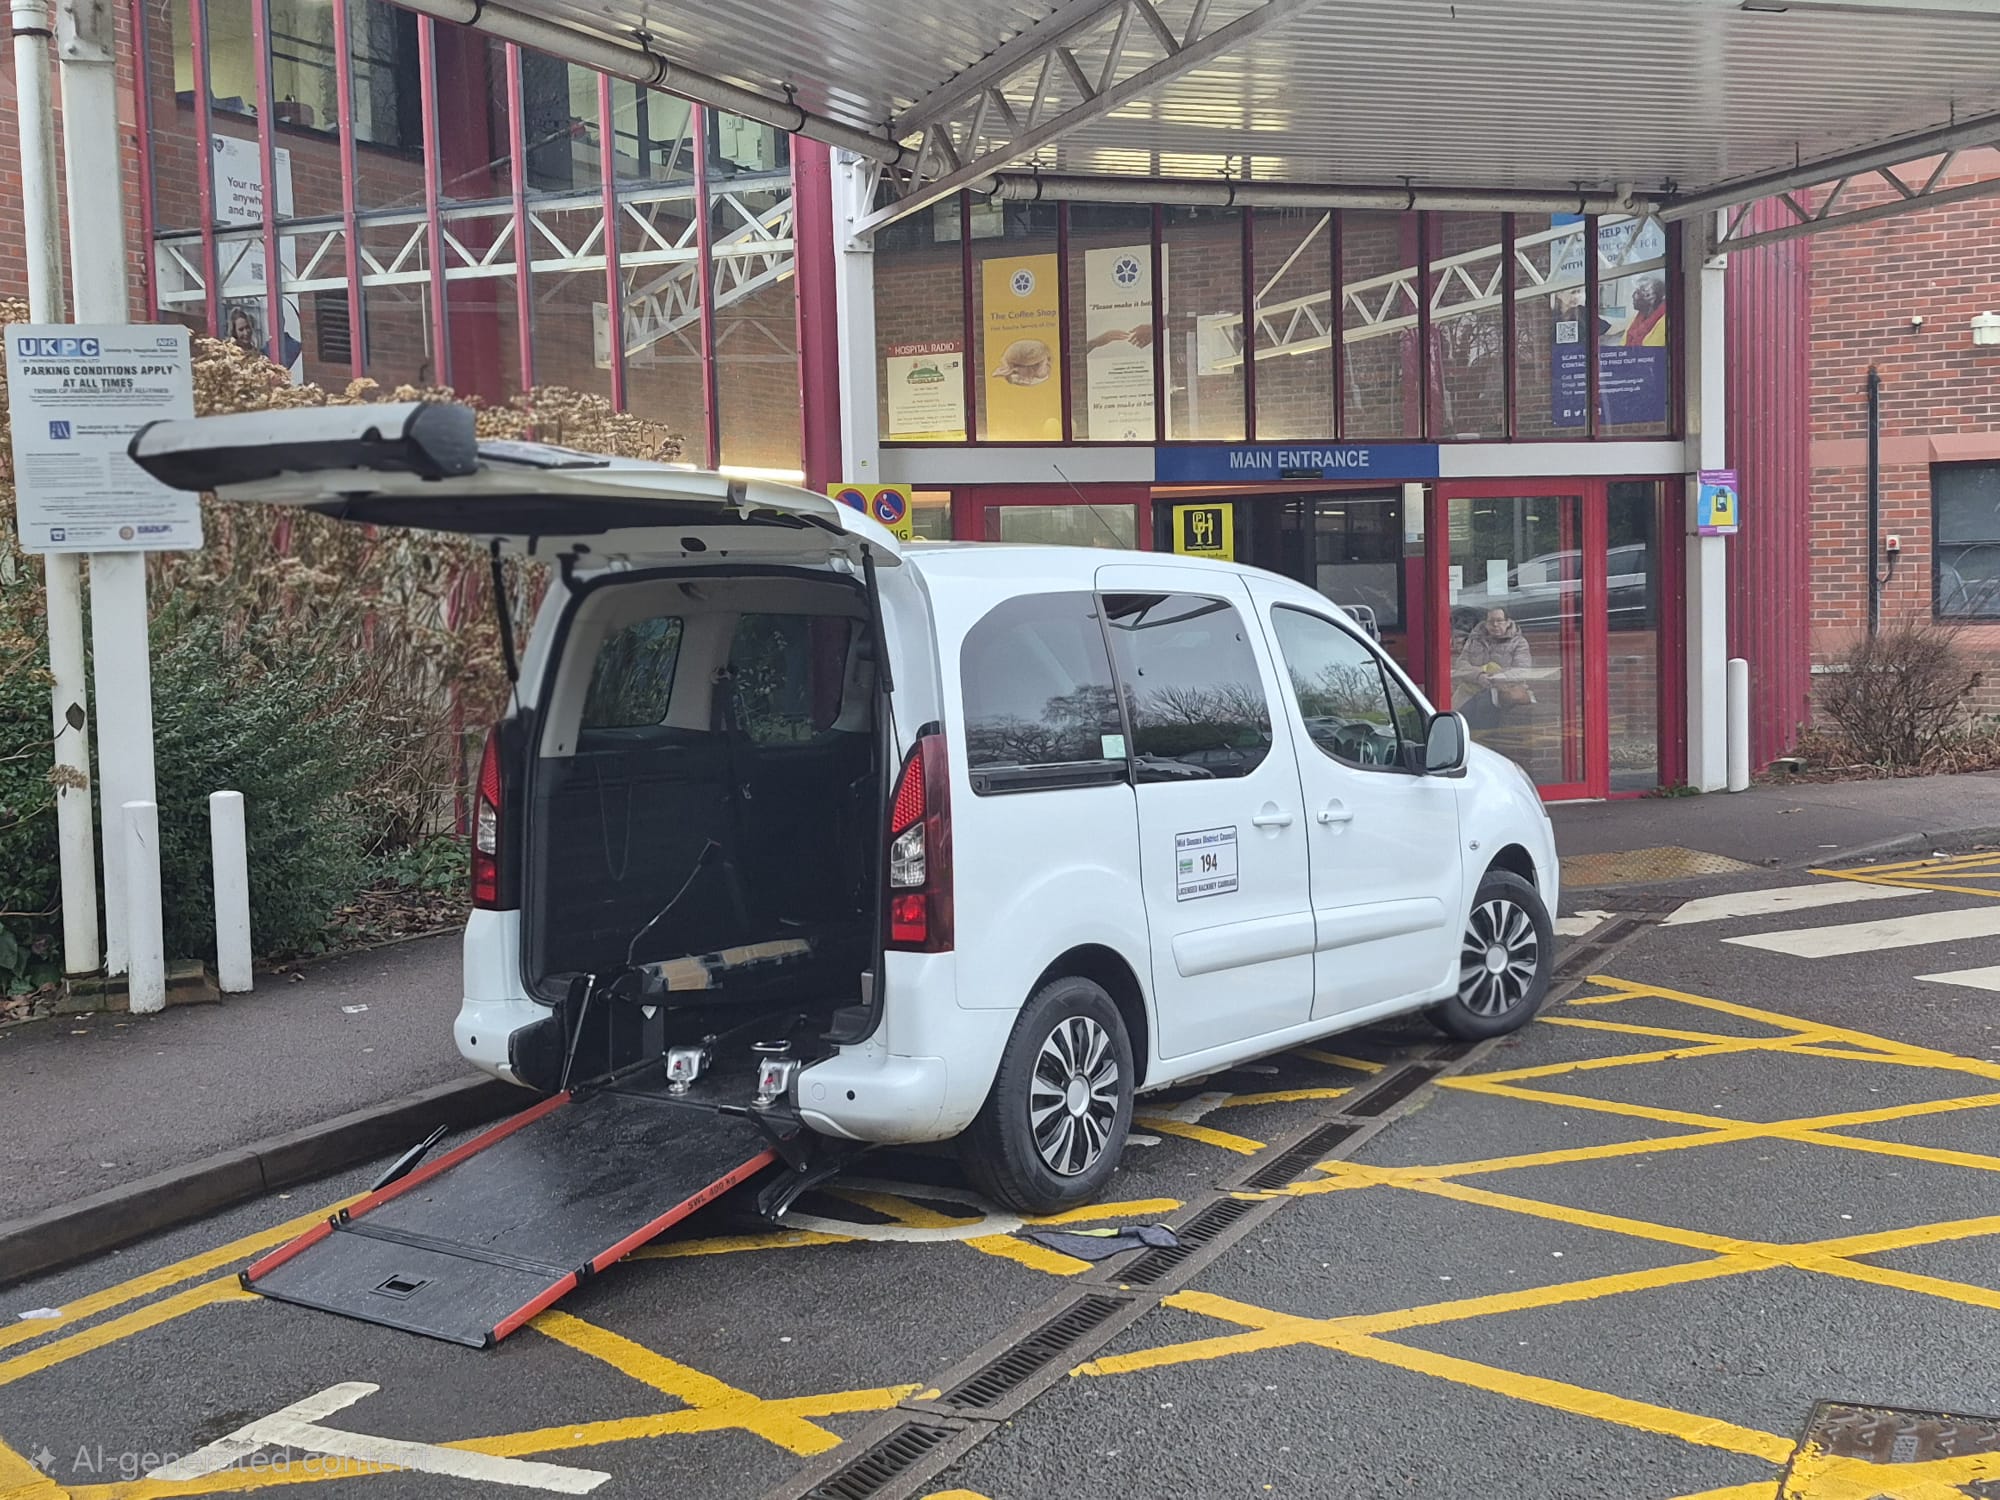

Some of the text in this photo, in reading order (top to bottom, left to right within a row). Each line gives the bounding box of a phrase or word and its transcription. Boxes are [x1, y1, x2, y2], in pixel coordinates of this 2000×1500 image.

[227, 176, 262, 192] Your rec
[233, 193, 262, 205] anywh
[228, 206, 262, 220] and any
[1599, 227, 1621, 239] HELP
[1560, 260, 1583, 270] WITH
[991, 308, 1056, 320] The Coffee Shop
[18, 338, 99, 356] UKPC
[894, 342, 954, 355] HOSPITAL RADIO
[23, 366, 173, 375] PARKING CONDITIONS APPLY
[63, 378, 134, 387] AT ALL TIMES
[1230, 450, 1369, 469] MAIN ENTRANCE
[1201, 853, 1218, 872] 194
[687, 1194, 706, 1210] SWL
[709, 1183, 724, 1196] 400
